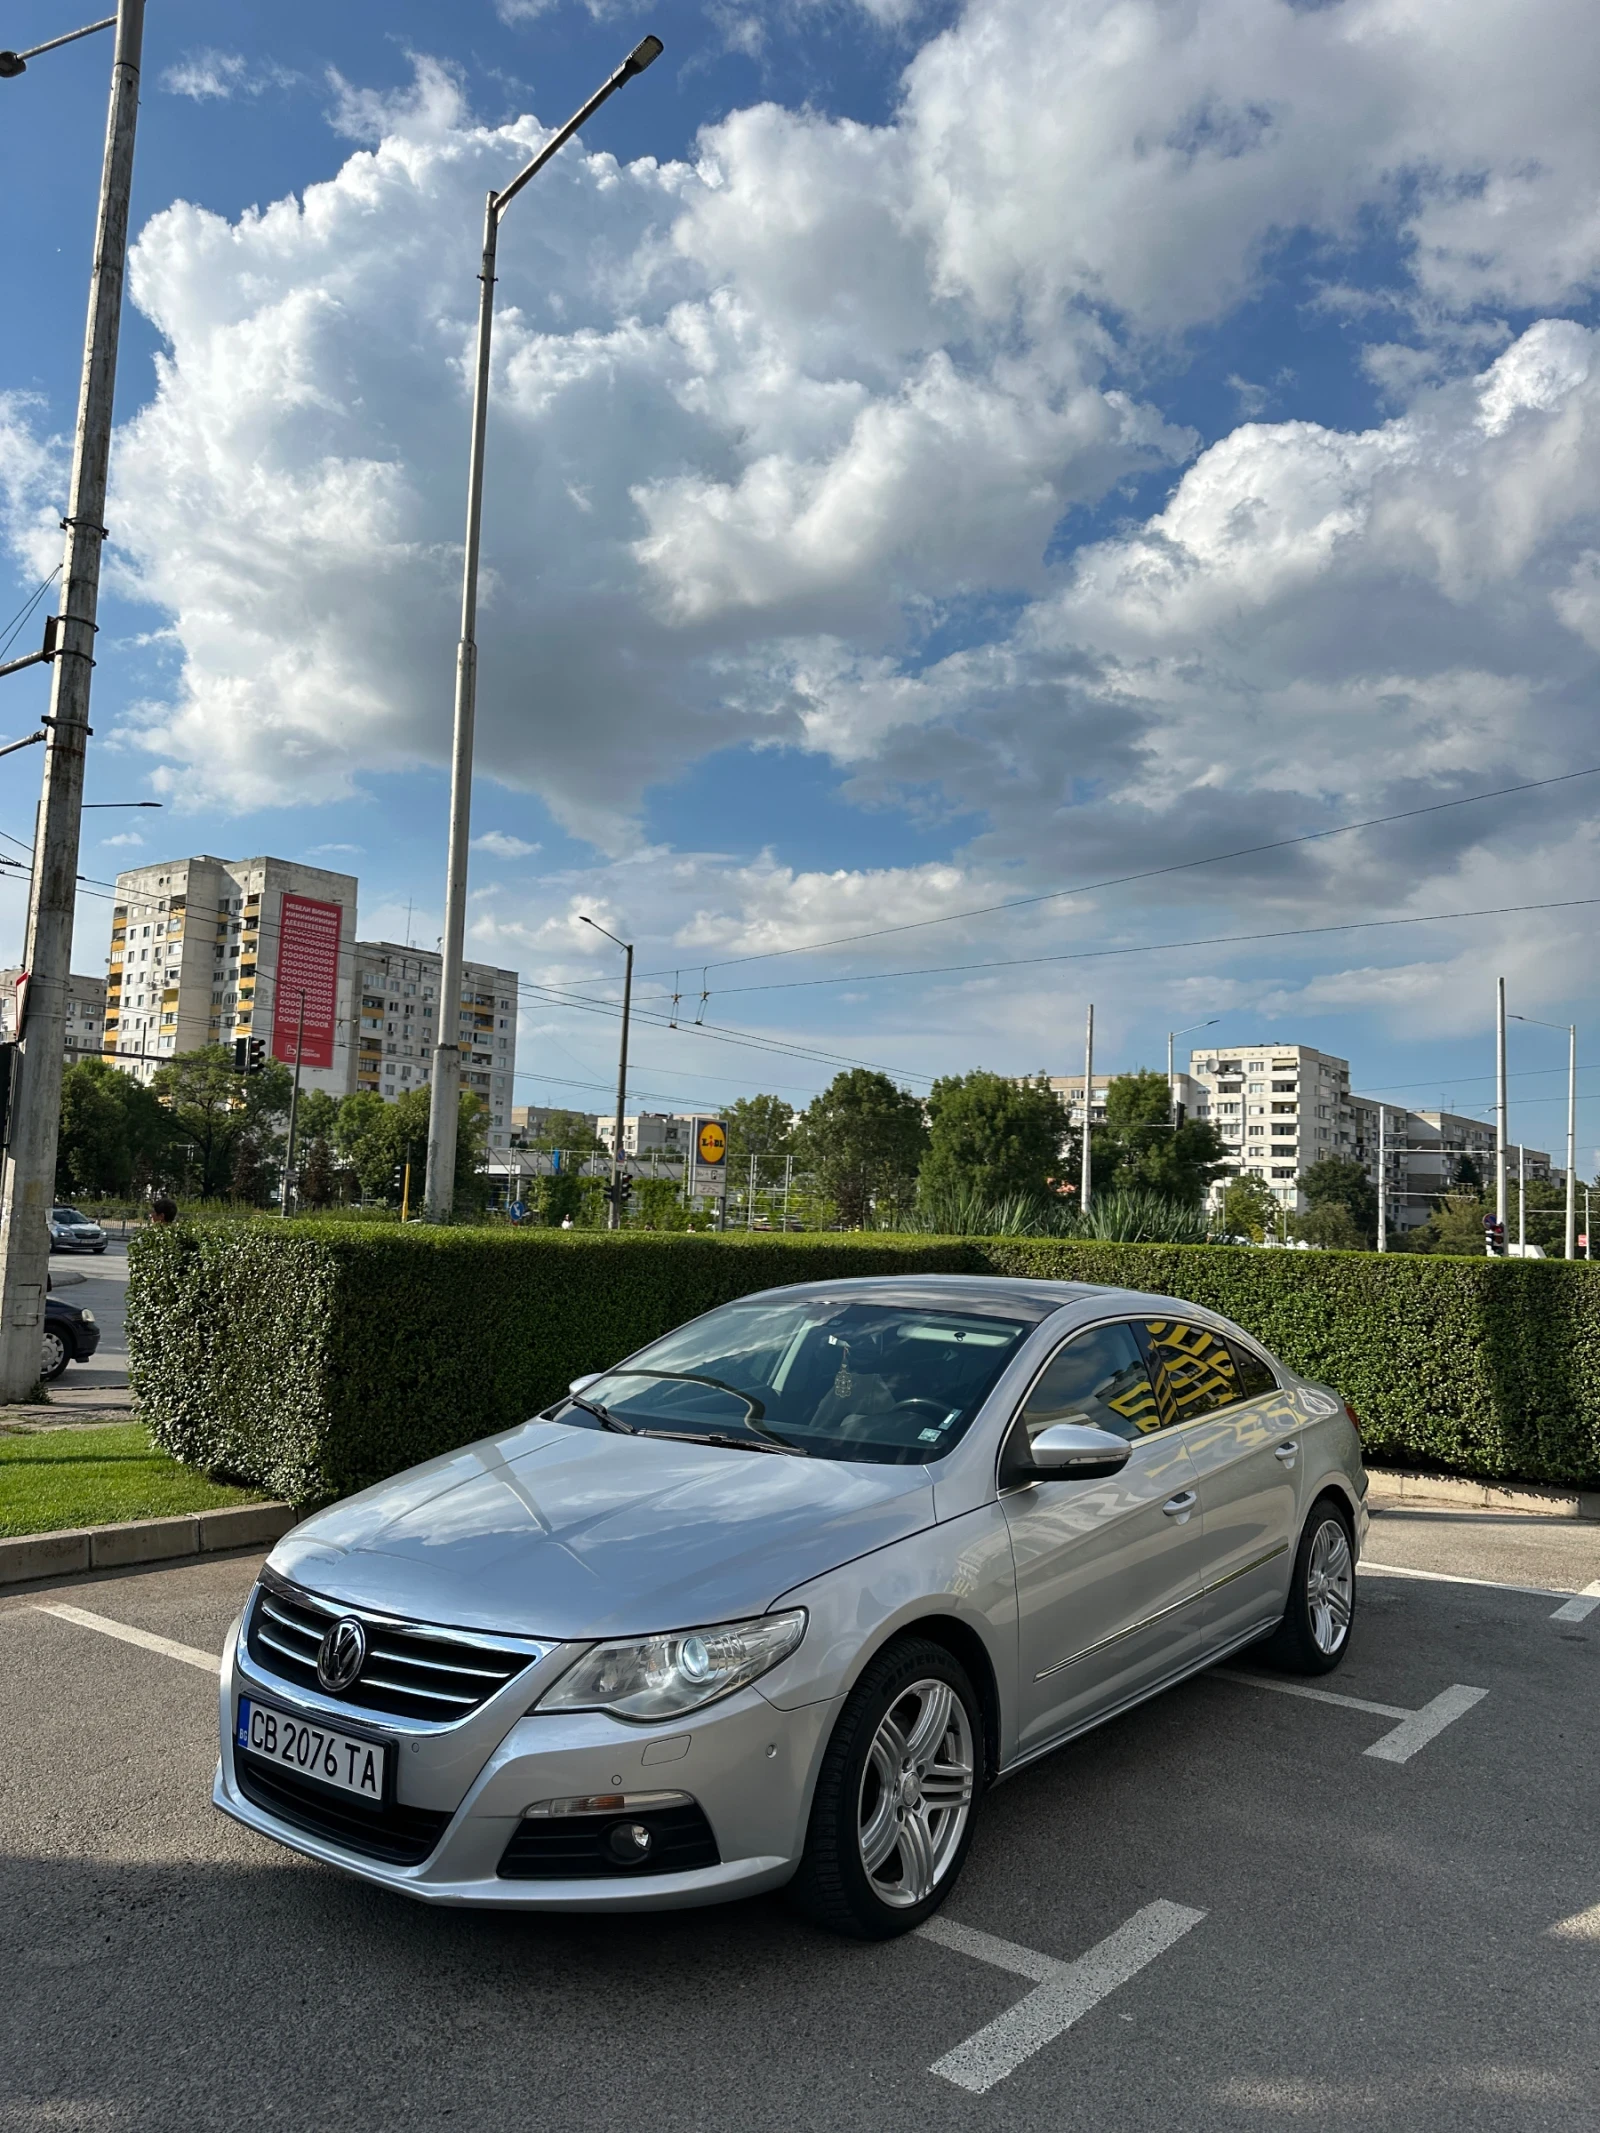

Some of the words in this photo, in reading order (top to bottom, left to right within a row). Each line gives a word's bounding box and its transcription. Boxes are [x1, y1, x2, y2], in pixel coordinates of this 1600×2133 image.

[286, 903, 311, 913] МЕБЕЛИ
[239, 1728, 248, 1742] BG
[251, 1709, 278, 1754] CB
[281, 1722, 338, 1777] 2076
[344, 1742, 377, 1792] TA
